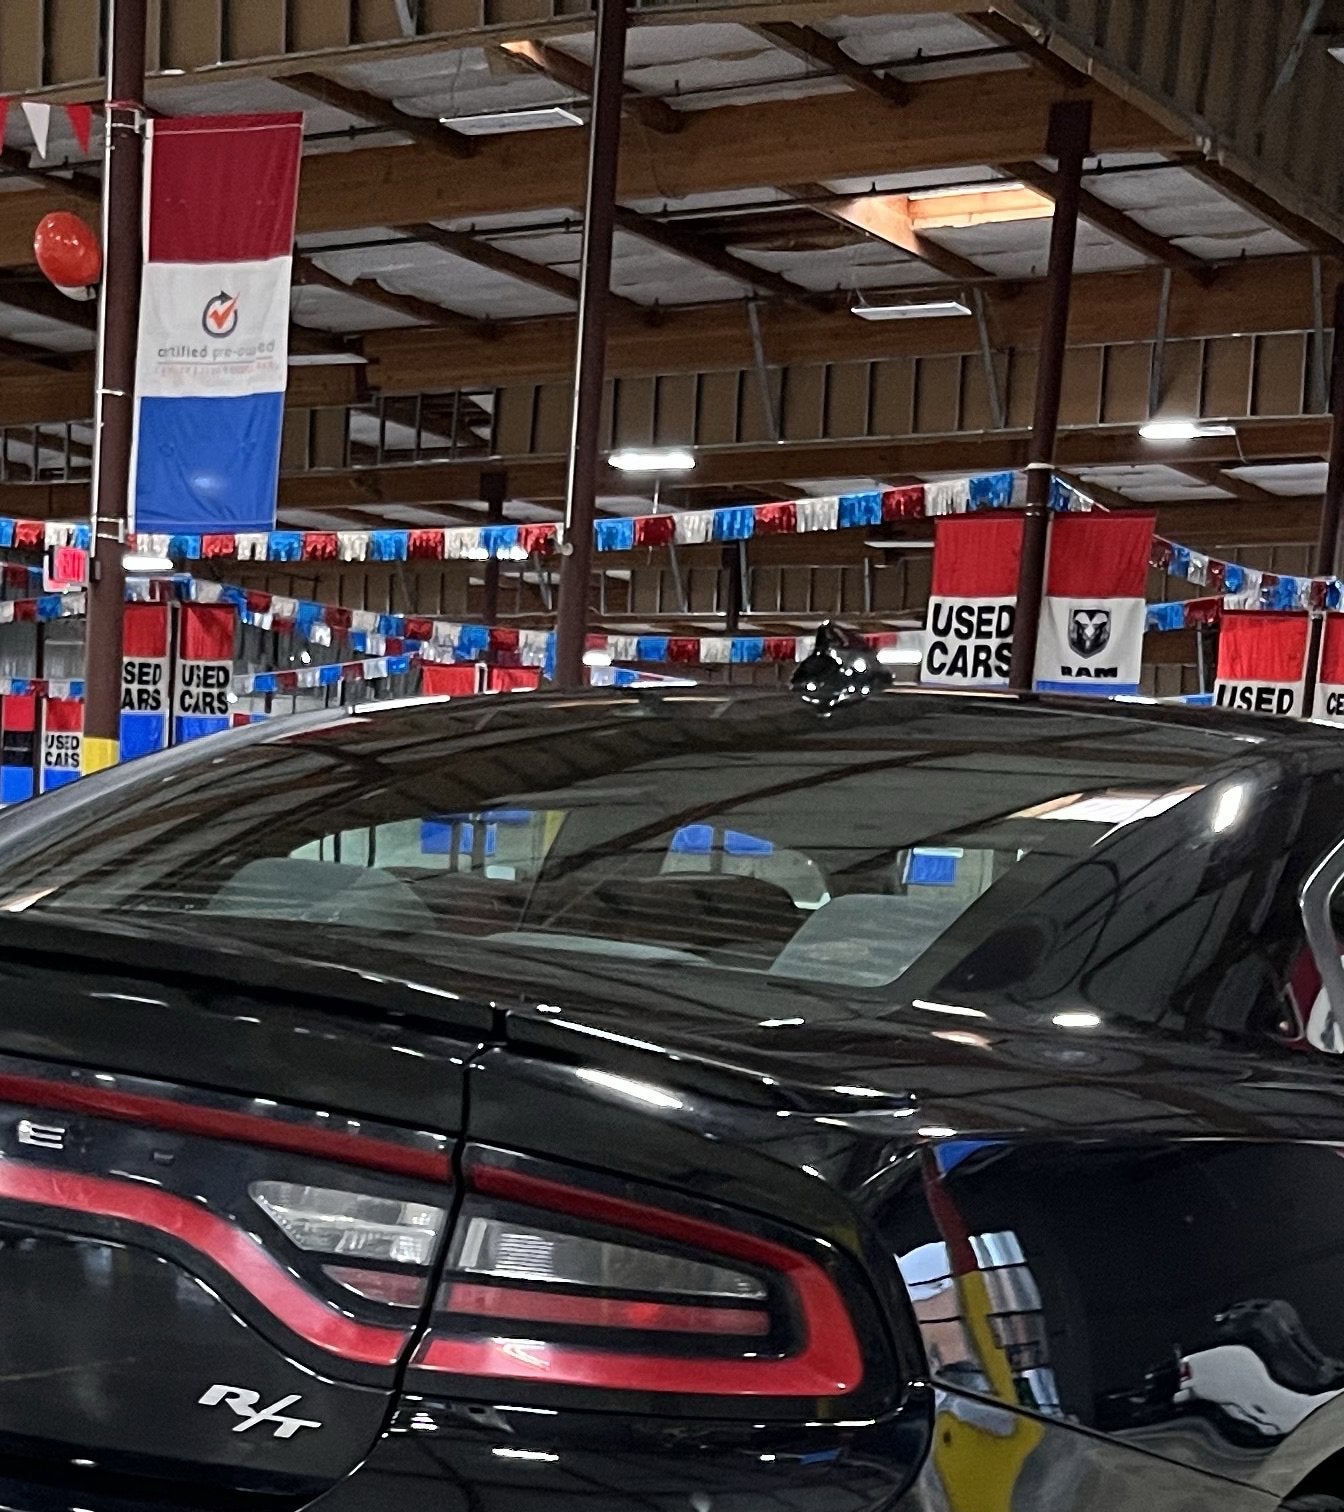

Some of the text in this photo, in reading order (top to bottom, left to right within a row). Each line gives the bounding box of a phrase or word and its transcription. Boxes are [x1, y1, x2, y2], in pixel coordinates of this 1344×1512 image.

[212, 340, 275, 362] pre-owed
[932, 603, 1015, 640] USED
[927, 640, 1013, 678] CARS
[123, 661, 162, 686] SED
[182, 663, 230, 690] USED
[122, 687, 162, 711] ARS
[180, 690, 229, 715] CARS
[1216, 684, 1294, 715] USED
[45, 734, 80, 750] USED
[197, 1384, 323, 1439] R/T
